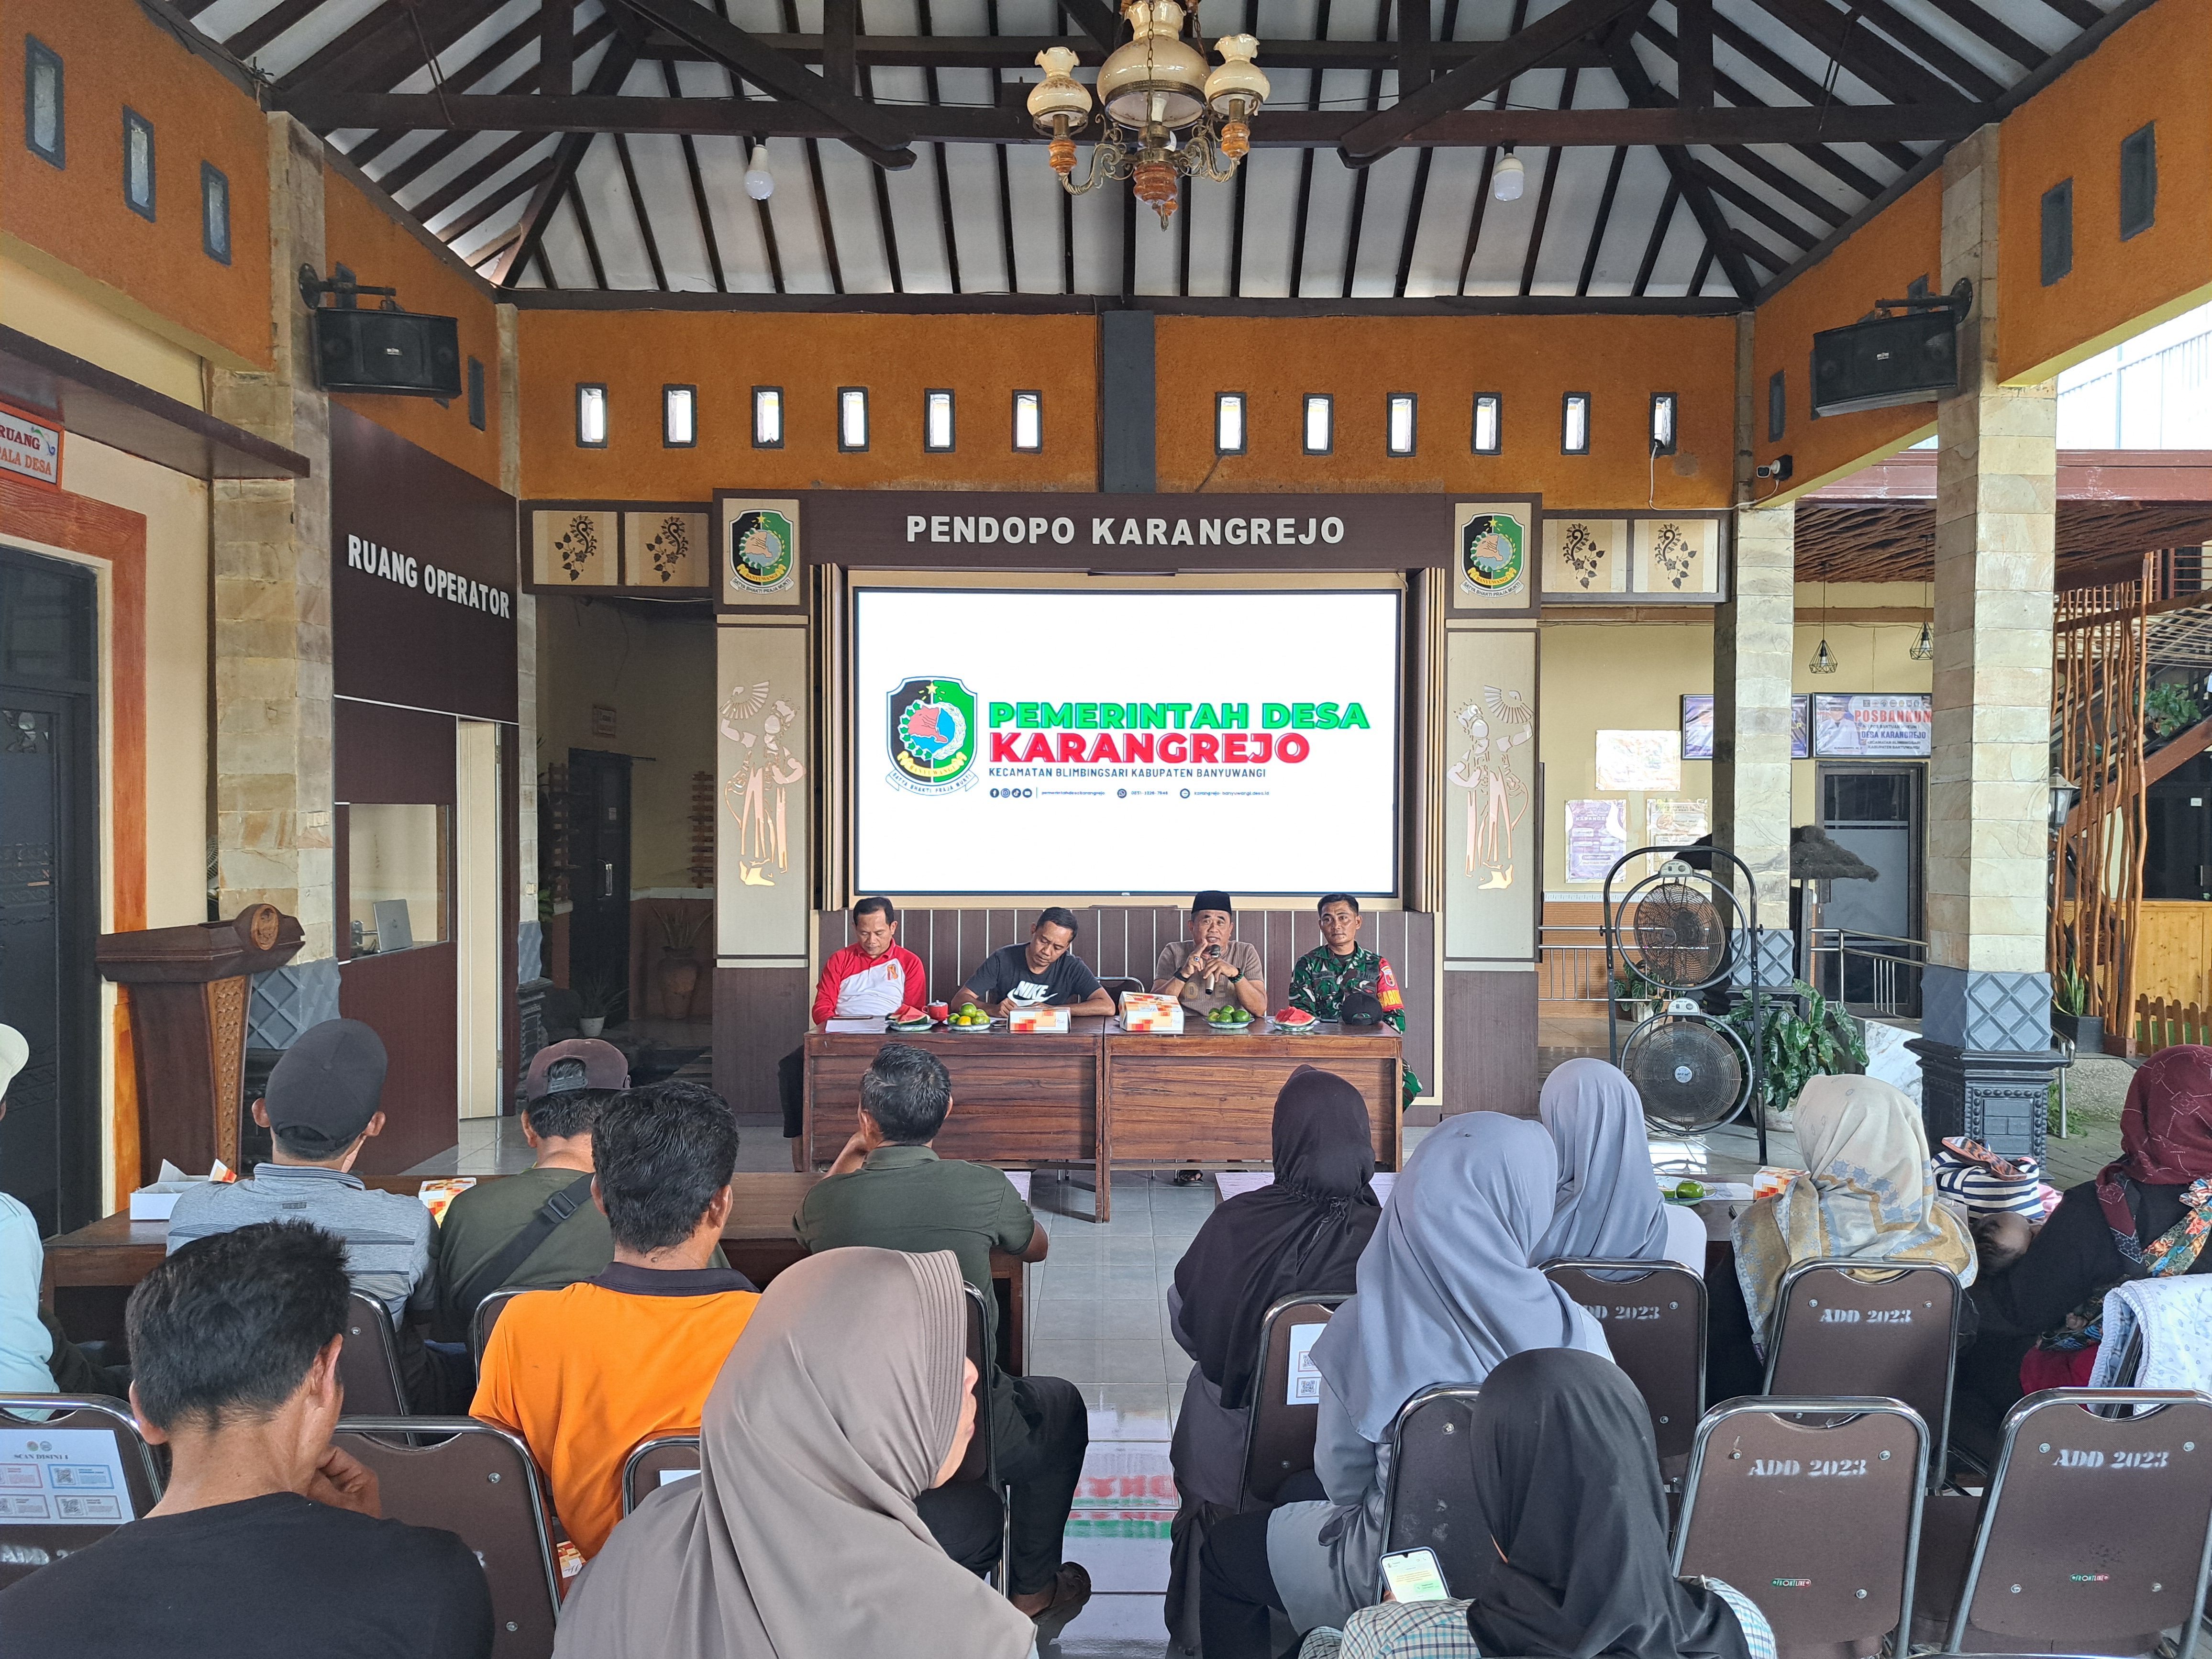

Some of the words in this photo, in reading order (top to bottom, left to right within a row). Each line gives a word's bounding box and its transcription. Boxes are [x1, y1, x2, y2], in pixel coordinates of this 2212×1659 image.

[0, 425, 41, 450] RUANG
[0, 447, 22, 466] ALA
[24, 454, 52, 476] DESA
[906, 515, 1075, 544] PENDOPO
[1092, 517, 1346, 545] KARANGREJO
[348, 534, 418, 588] RUANG
[424, 564, 510, 619] OPERATOR
[733, 578, 746, 589] SATYA
[779, 578, 791, 589] MUKTI
[746, 573, 778, 582] BANYUWANGI
[1463, 581, 1476, 592] SATYA
[1476, 588, 1493, 597] BHAKTI
[1508, 581, 1521, 593] MUKTI
[989, 702, 1249, 729] PEMERINTAH
[1262, 702, 1371, 730] DESA
[1854, 710, 1932, 723] POSBANKUM
[1880, 731, 1926, 739] KARANGREJO
[989, 732, 1310, 764] KARANGREJO
[909, 765, 956, 775] BANYUWANGI
[989, 768, 1052, 777] KECAMATAN
[1056, 768, 1128, 777] BLIMBINGSARI
[1131, 768, 1193, 777] KABUPATEN
[1197, 768, 1266, 777] BANYUWANGI
[892, 772, 908, 786] SATYA
[910, 784, 932, 793] BHAKTI
[956, 774, 972, 788] MUKTI
[1013, 980, 1049, 1000] NIKE
[1582, 1305, 1608, 1318] DD
[1615, 1305, 1660, 1320] 2023
[1819, 1309, 1860, 1323] ADD
[1866, 1309, 1912, 1323] 2023
[2052, 1449, 2104, 1467] ADD
[2110, 1450, 2170, 1468] 2023
[1748, 1459, 1800, 1476] ADD
[1808, 1460, 1867, 1476] 2023
